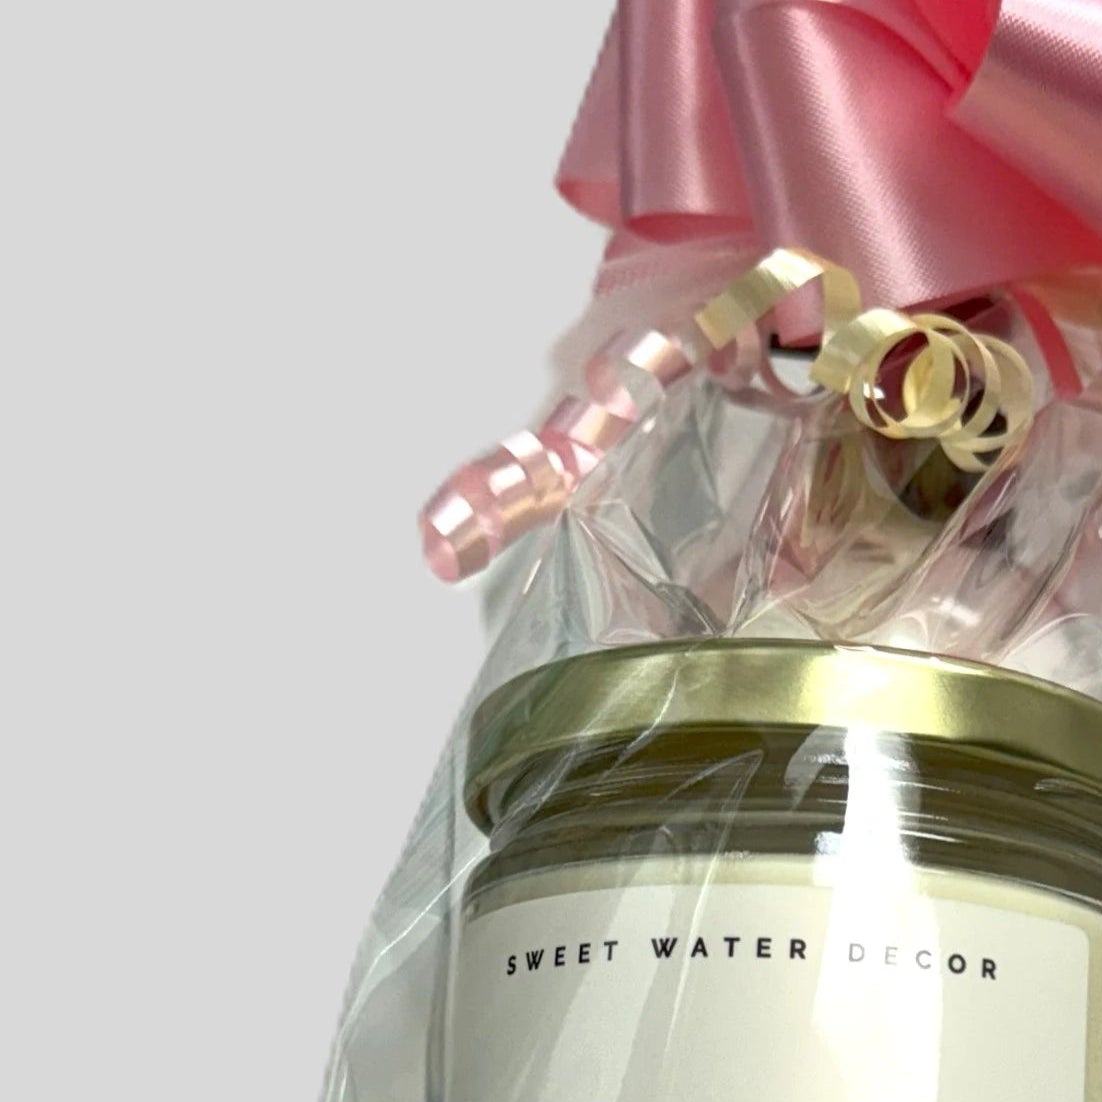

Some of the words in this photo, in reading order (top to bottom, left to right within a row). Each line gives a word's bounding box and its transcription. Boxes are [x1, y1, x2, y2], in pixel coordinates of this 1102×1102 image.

[507, 940, 619, 975] SWEET
[651, 936, 808, 961] WATER
[848, 942, 998, 980] DECOR
